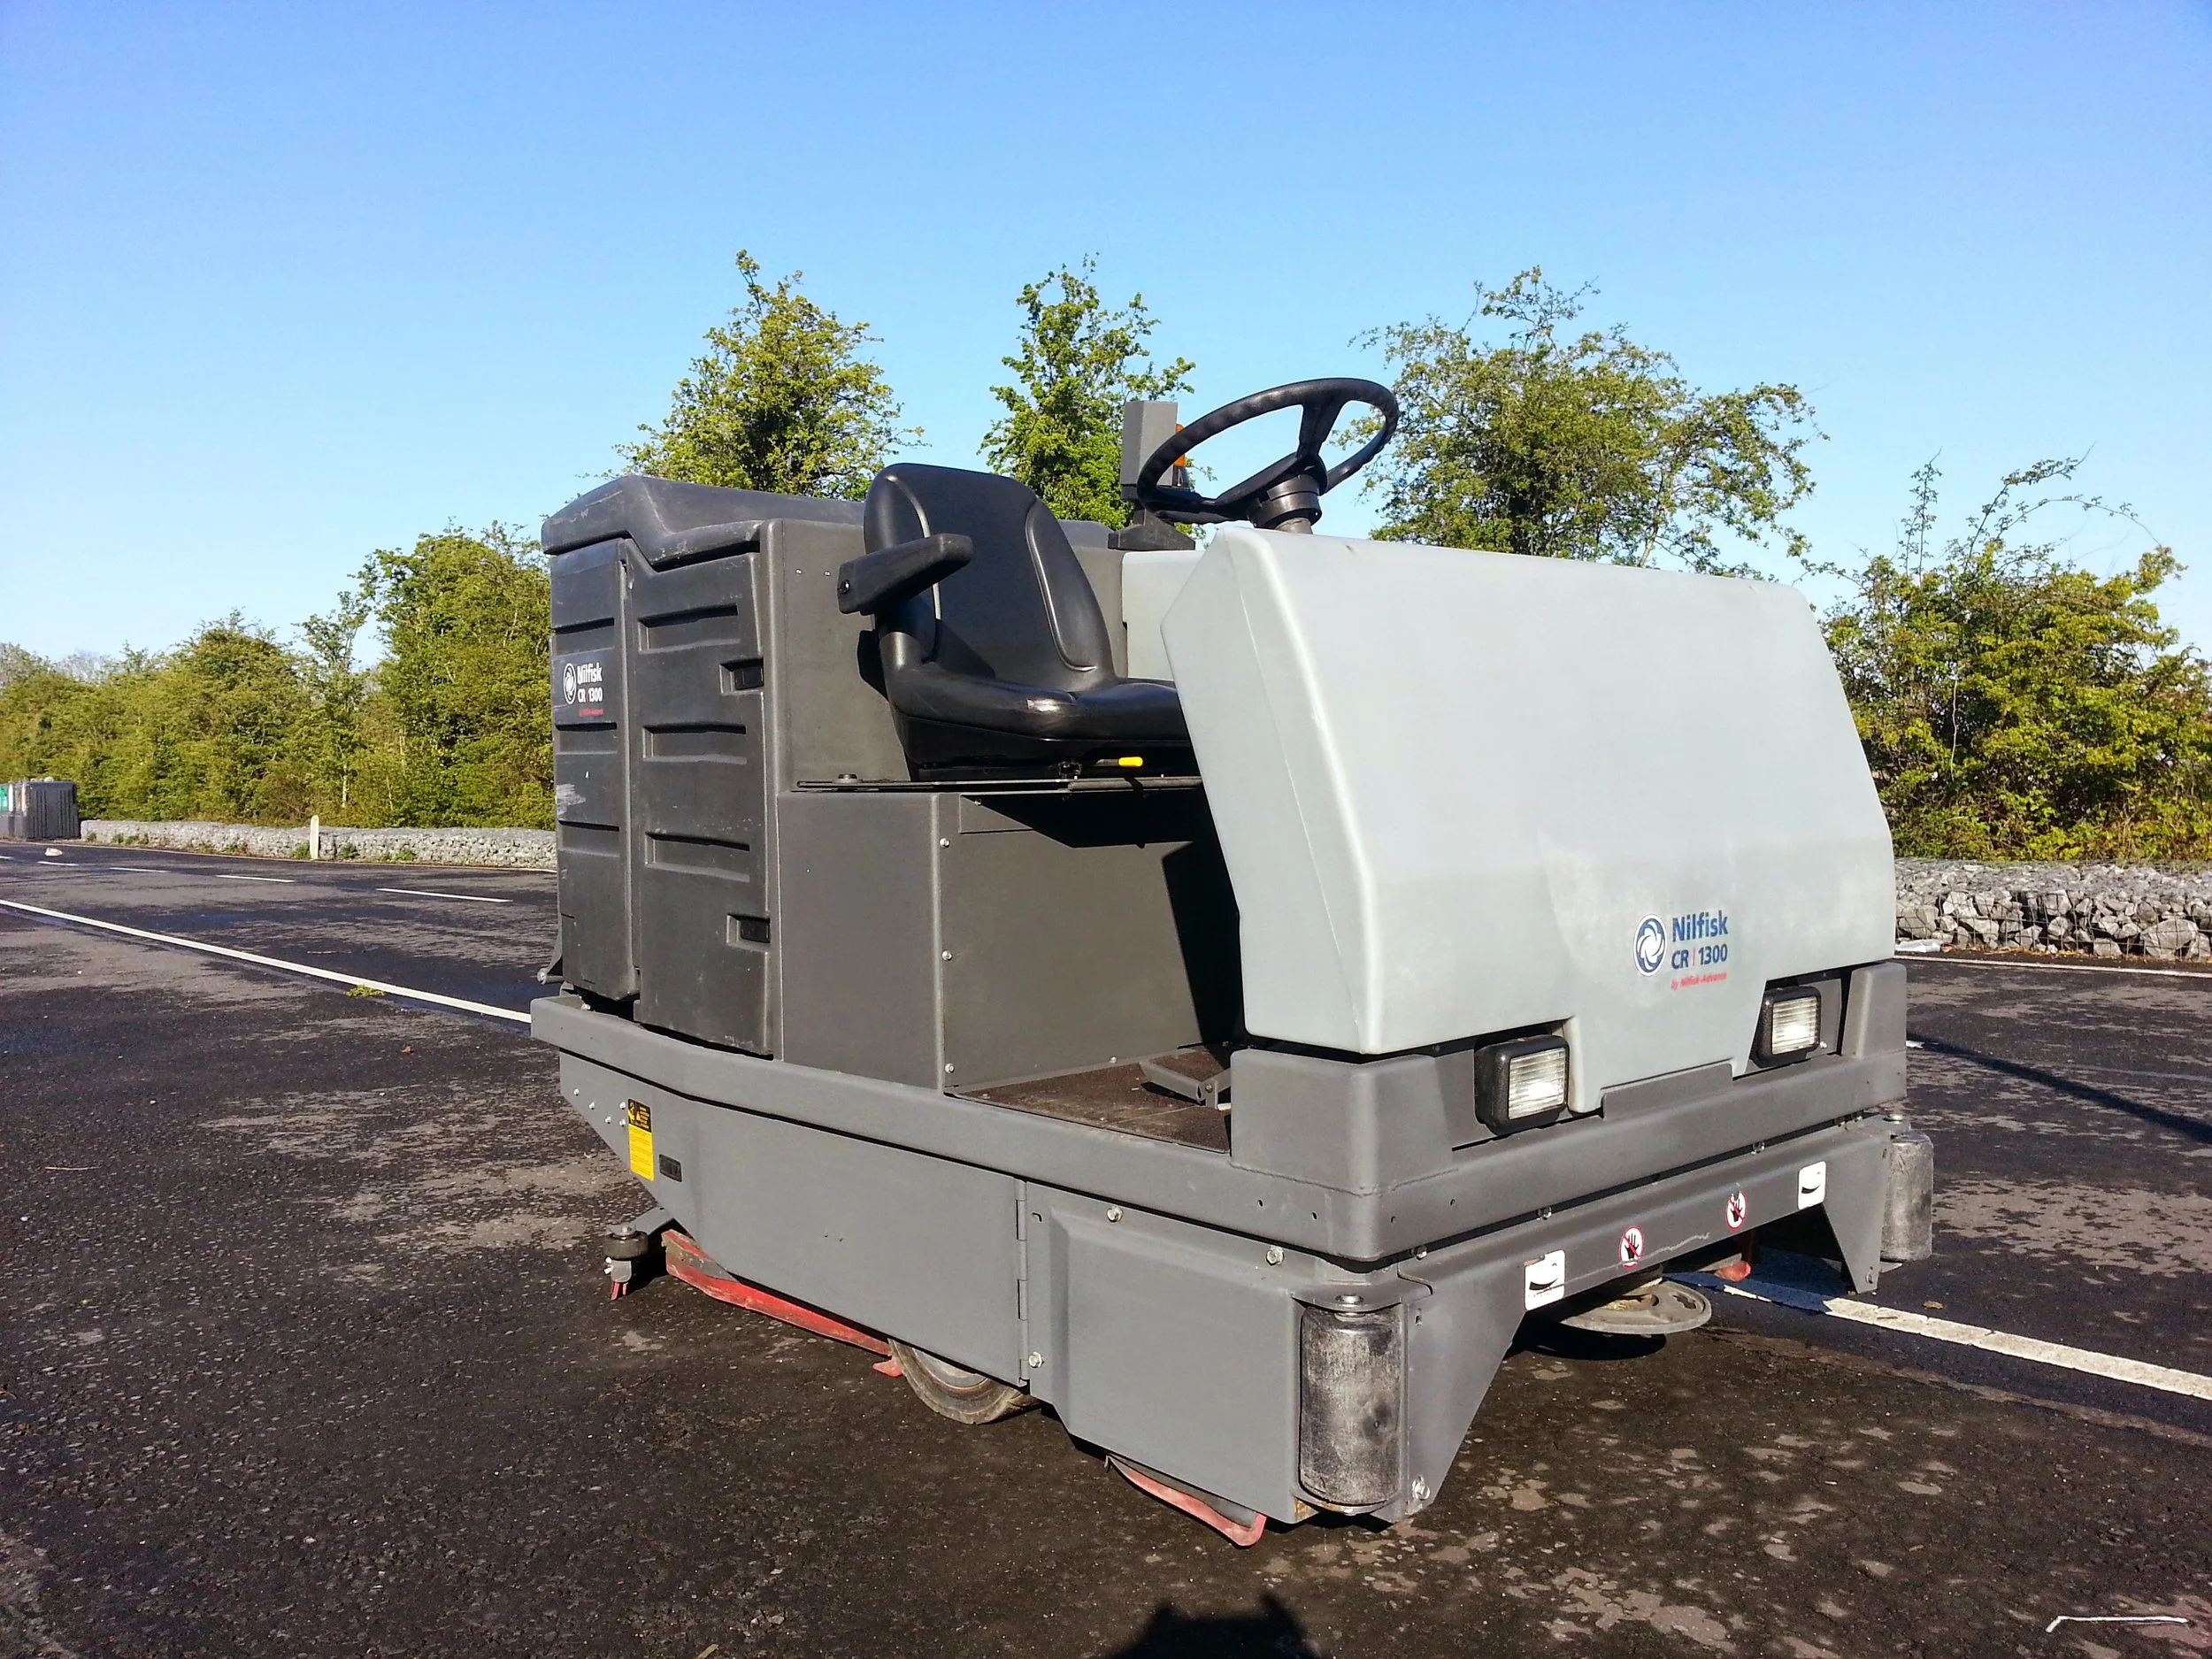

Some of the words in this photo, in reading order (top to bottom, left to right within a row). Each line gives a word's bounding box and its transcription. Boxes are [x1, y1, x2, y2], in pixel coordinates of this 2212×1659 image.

[577, 662, 603, 685] Nilfisk
[578, 688, 586, 703] CR
[588, 687, 603, 703] 1300
[1672, 910, 1728, 942] Nilfisk
[1671, 949, 1689, 970] CR
[1698, 943, 1728, 965] 1300
